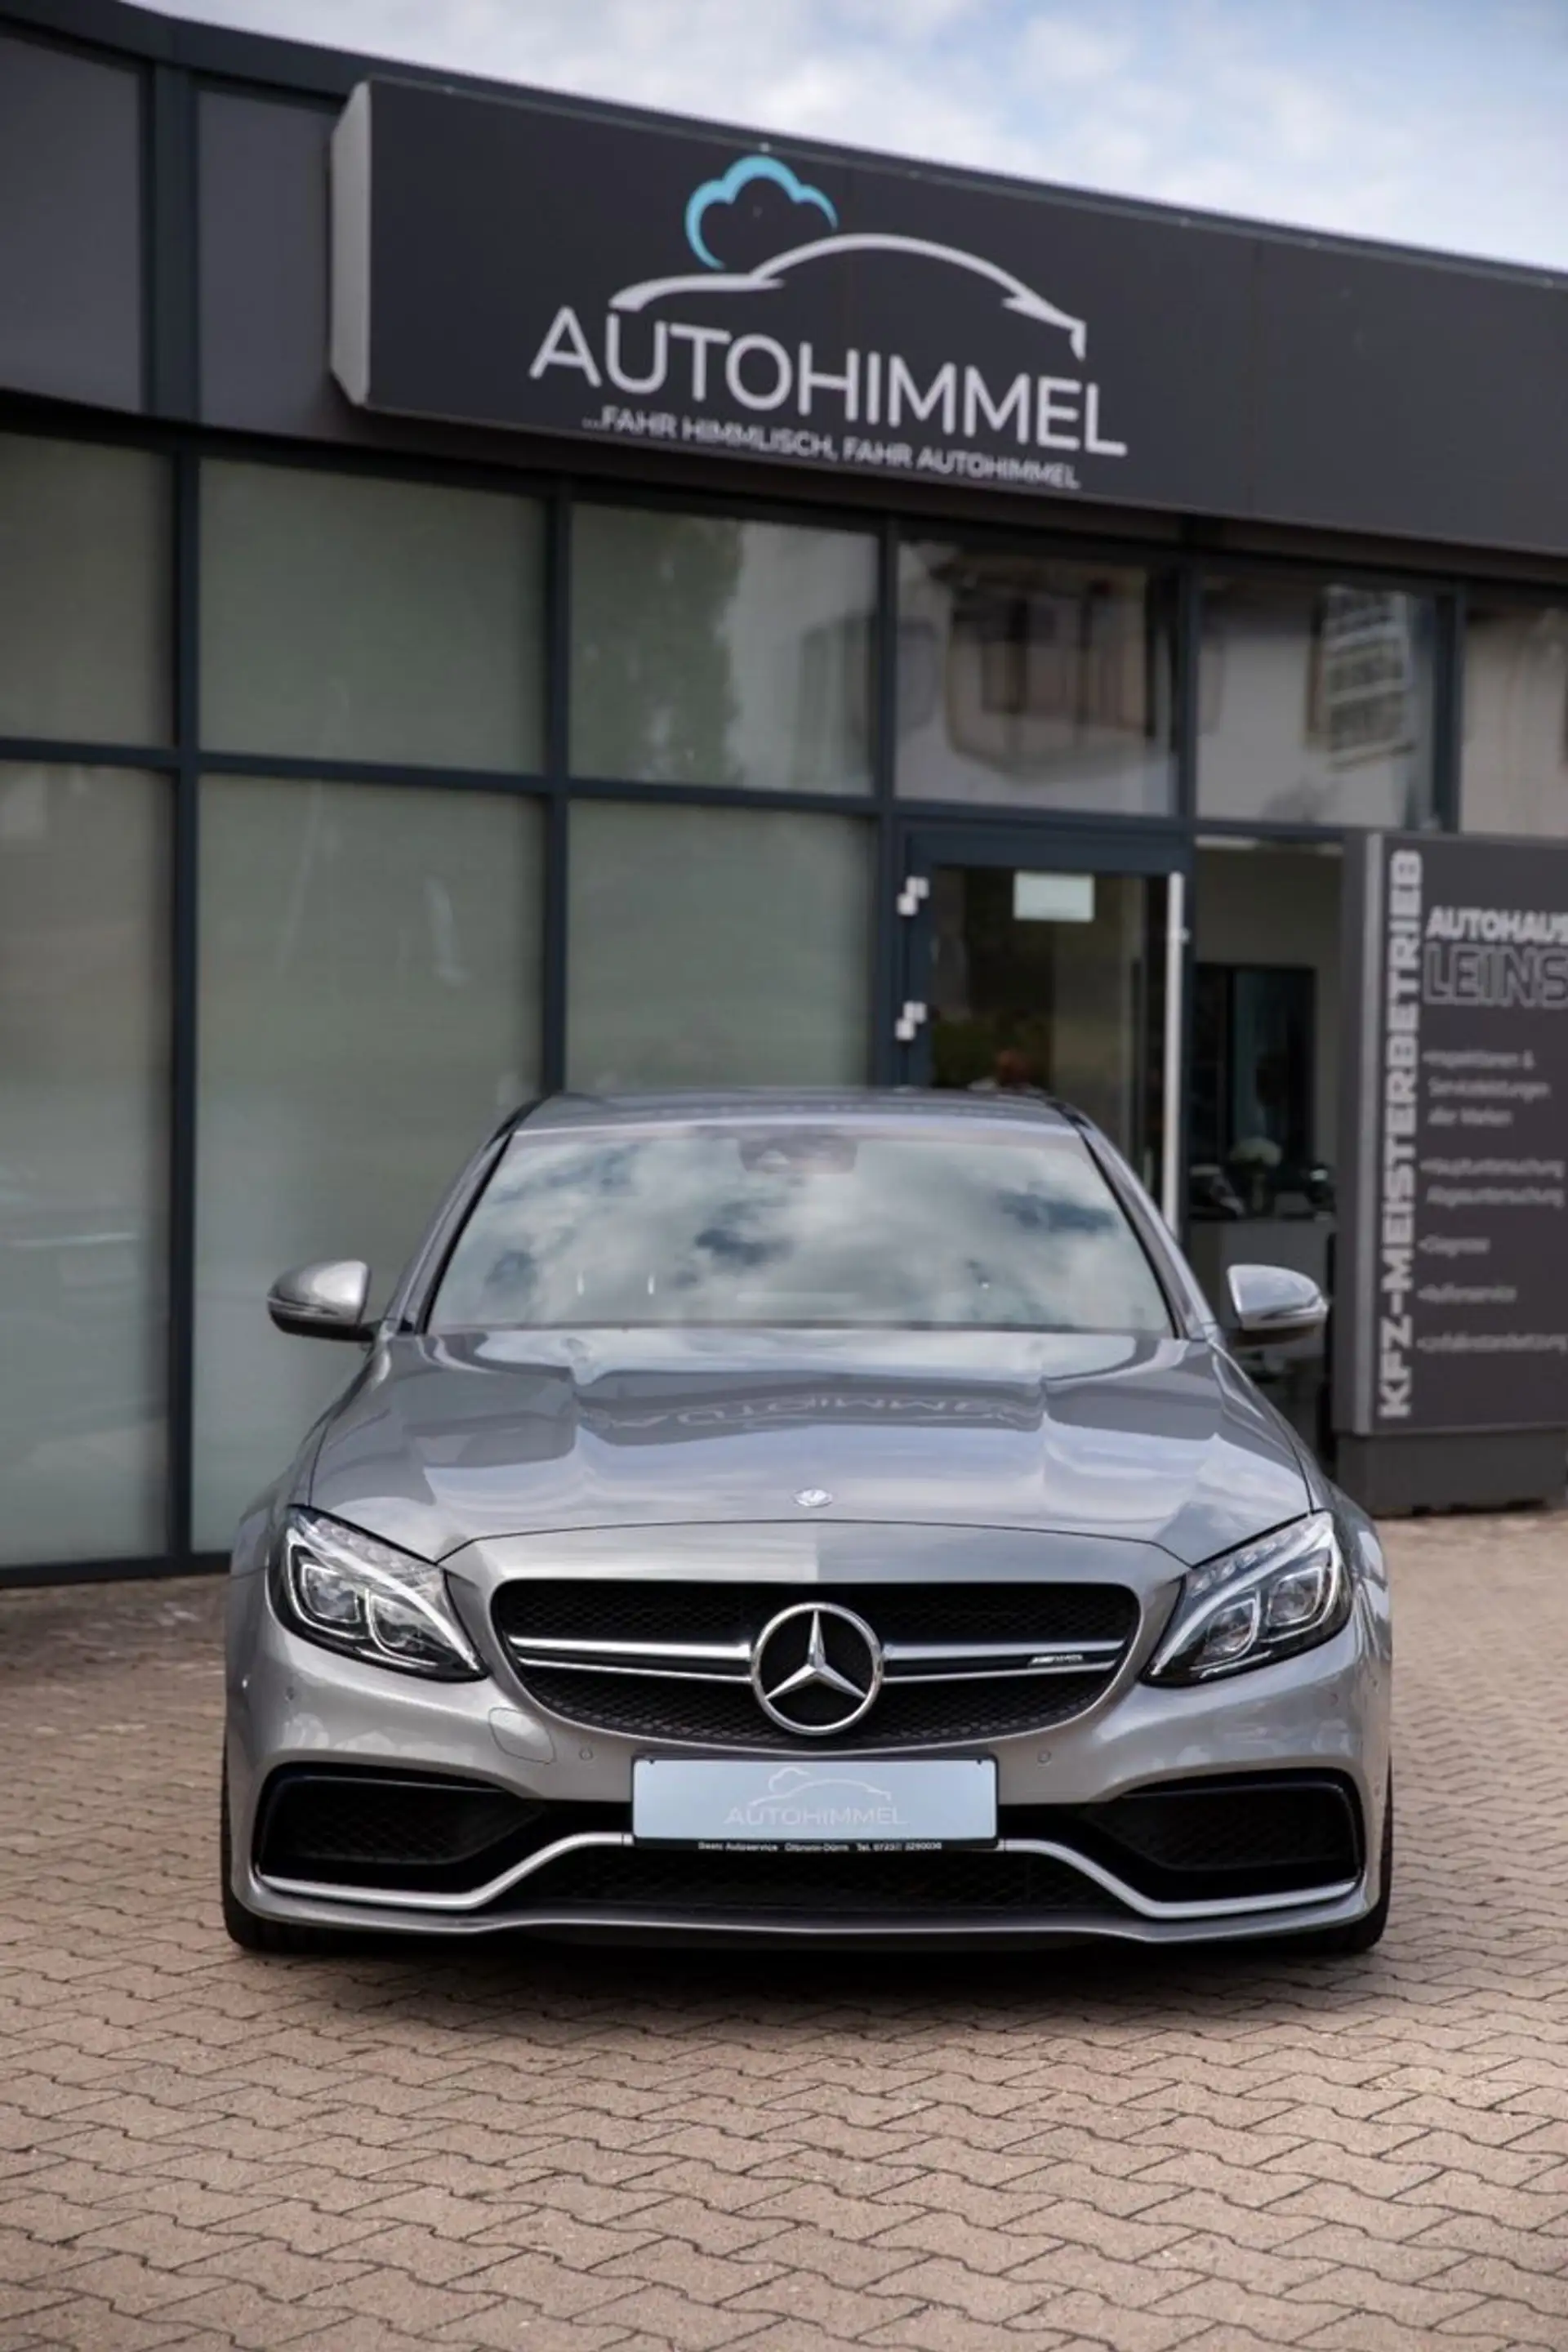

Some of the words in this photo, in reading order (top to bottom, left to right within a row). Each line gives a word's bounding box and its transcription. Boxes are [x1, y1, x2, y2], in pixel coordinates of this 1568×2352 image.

[528, 305, 1127, 457] AUTOHIMMEL
[681, 415, 839, 462] HIMMLISCH,
[843, 435, 913, 469] FAHR
[916, 445, 1082, 489] AUTOHIMMEL
[1378, 849, 1422, 1419] KFZ-MEISTERBETRIEB
[723, 1806, 909, 1827] AUTOHIMMEL
